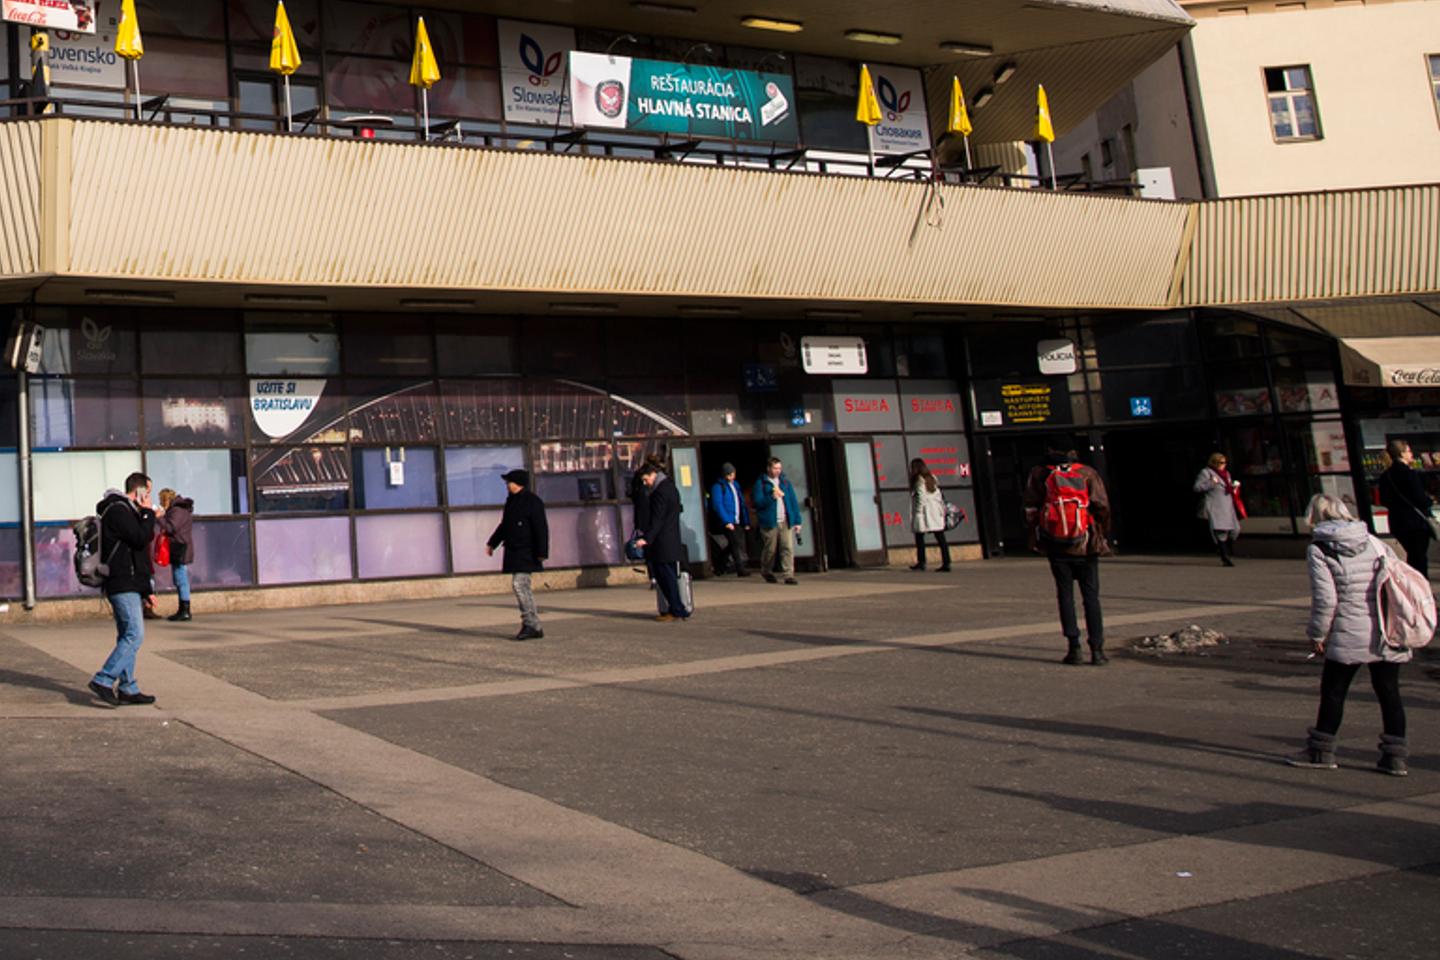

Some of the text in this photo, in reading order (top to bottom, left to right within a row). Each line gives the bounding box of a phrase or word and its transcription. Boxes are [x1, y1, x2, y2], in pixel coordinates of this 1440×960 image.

[48, 46, 116, 65] ovensko
[512, 86, 570, 108] Slowake
[637, 95, 693, 118] HLAVNÁ
[694, 102, 753, 124] STANICA
[286, 382, 296, 394] SI
[253, 398, 312, 411] BRATISLAVU
